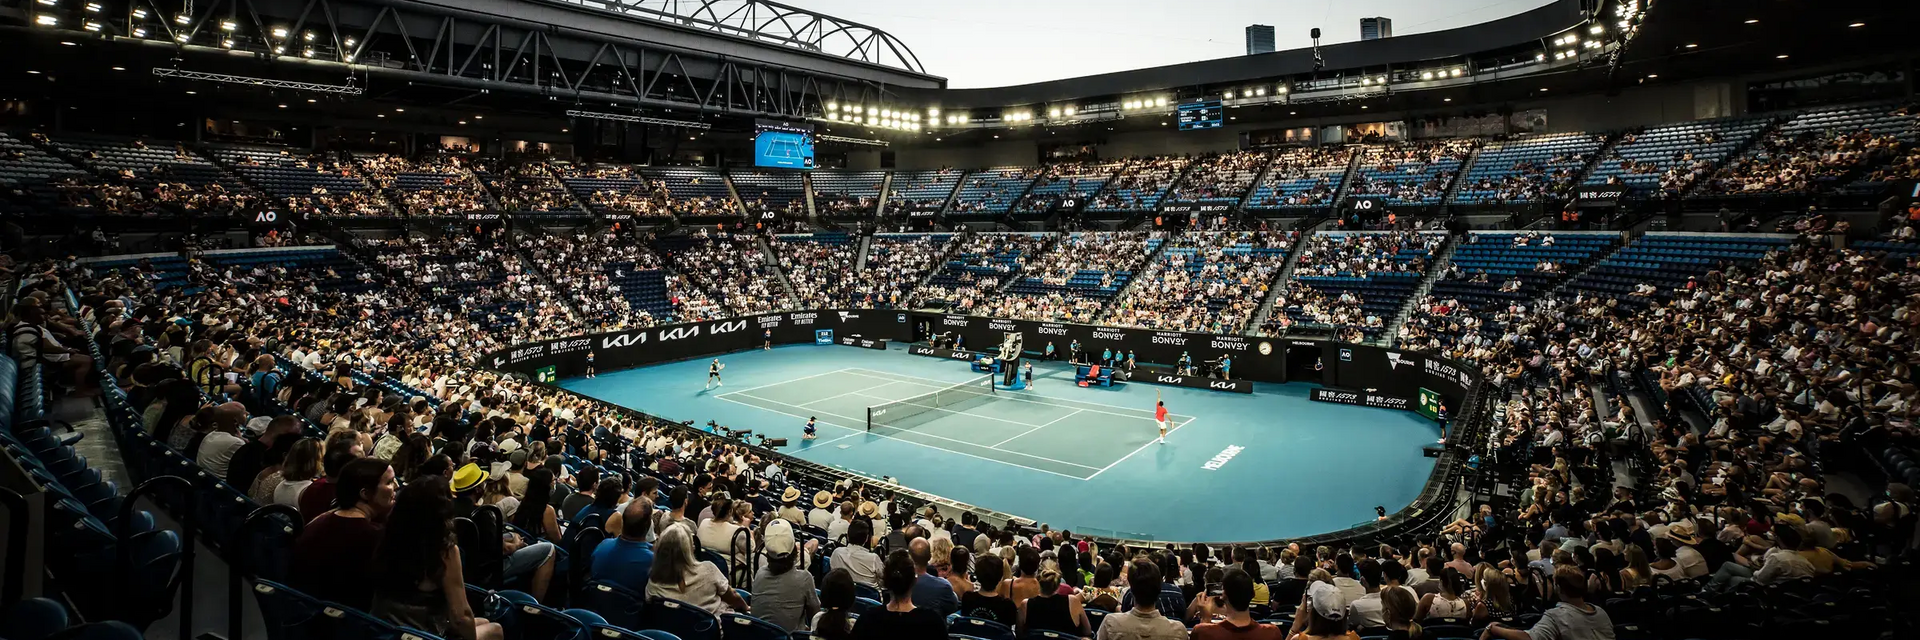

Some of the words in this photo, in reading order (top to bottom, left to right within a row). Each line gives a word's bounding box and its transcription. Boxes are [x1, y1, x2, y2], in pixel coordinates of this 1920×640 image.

[1062, 199, 1075, 207] AO
[1354, 200, 1372, 210] AO
[255, 211, 277, 222] AO
[757, 315, 783, 324] Emirates
[790, 312, 818, 320] Emirates
[710, 319, 747, 335] KIA
[943, 319, 968, 327] BONVOY
[989, 323, 1015, 331] BONVOY
[659, 325, 699, 342] KIA
[1038, 327, 1067, 336] BONVOY
[602, 331, 647, 349] KIA
[1092, 332, 1124, 341] BONVOY
[1151, 336, 1186, 346] BONVOY
[1211, 340, 1248, 350] BONVOY
[1157, 375, 1183, 384] KIA
[1210, 380, 1237, 390] KIA
